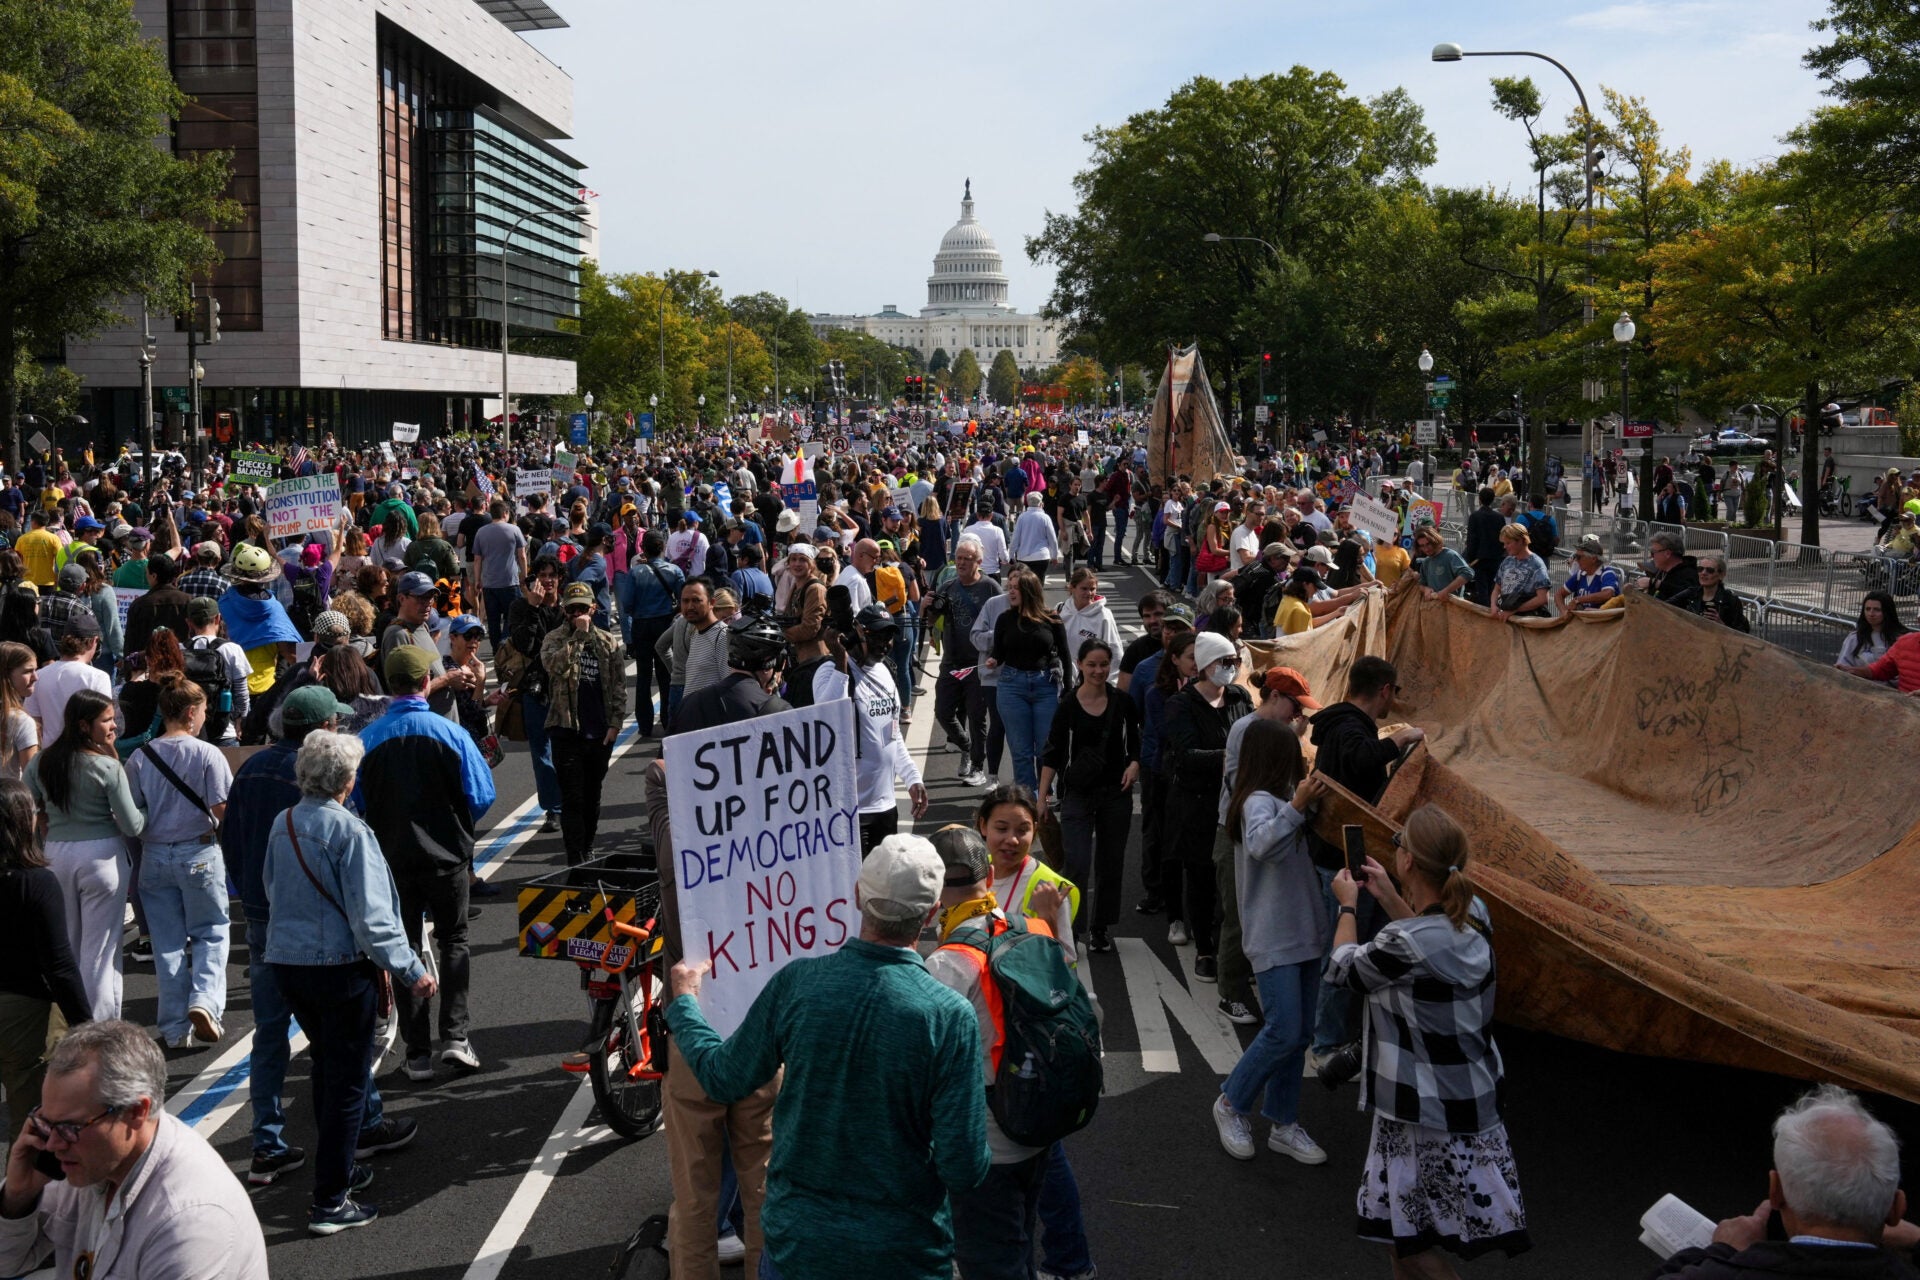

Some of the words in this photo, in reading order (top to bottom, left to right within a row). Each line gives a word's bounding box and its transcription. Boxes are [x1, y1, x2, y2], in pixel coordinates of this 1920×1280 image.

[236, 466, 273, 478] BALANCES
[237, 459, 266, 470] CHECKS
[266, 462, 273, 471] &
[517, 472, 529, 480] WE
[531, 470, 549, 478] NEED
[267, 478, 311, 497] DEFEND
[313, 474, 336, 488] THE
[266, 488, 340, 511] CONSTITUTION
[1356, 498, 1367, 509] SIC
[1368, 505, 1395, 522] SEMPER
[272, 508, 300, 524] NOT
[310, 503, 335, 518] THE
[1354, 511, 1387, 534] TYRANNIS
[271, 521, 302, 537] TRUMP
[306, 517, 336, 530] CULT
[870, 698, 895, 709] PHOT
[693, 719, 836, 791] STAND
[695, 795, 746, 836] UP
[764, 774, 832, 821] FOR
[681, 805, 859, 890] DEMOCRACY
[746, 870, 796, 915] NO
[570, 937, 592, 949] KEEP
[592, 942, 632, 955] ABOTION
[707, 898, 848, 979] KINGS
[574, 947, 600, 959] LEGAL
